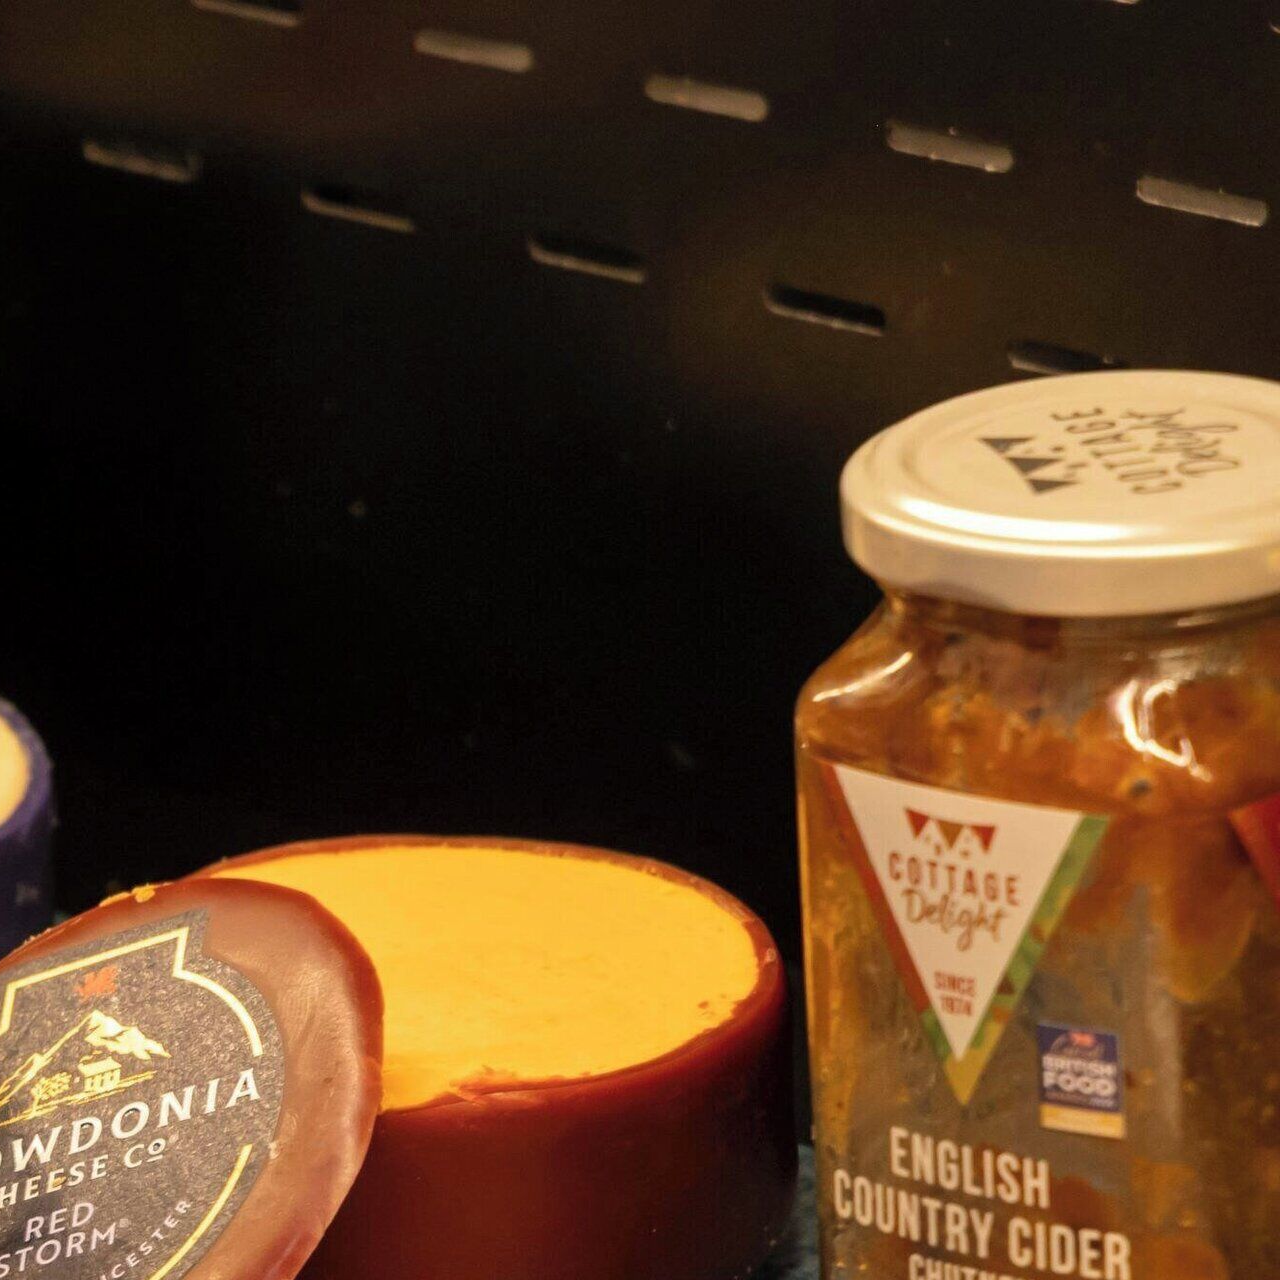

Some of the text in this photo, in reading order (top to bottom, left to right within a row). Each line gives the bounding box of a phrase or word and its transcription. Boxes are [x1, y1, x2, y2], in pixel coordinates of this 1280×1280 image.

[1050, 407, 1182, 494] COTTAGE
[889, 851, 1020, 907] COTTAGE
[900, 886, 1007, 952] Delight
[1042, 1070, 1117, 1097] FOOD
[890, 1126, 1051, 1209] ENGLISH
[24, 1202, 95, 1242] RED
[833, 1168, 995, 1260] COUNTRY
